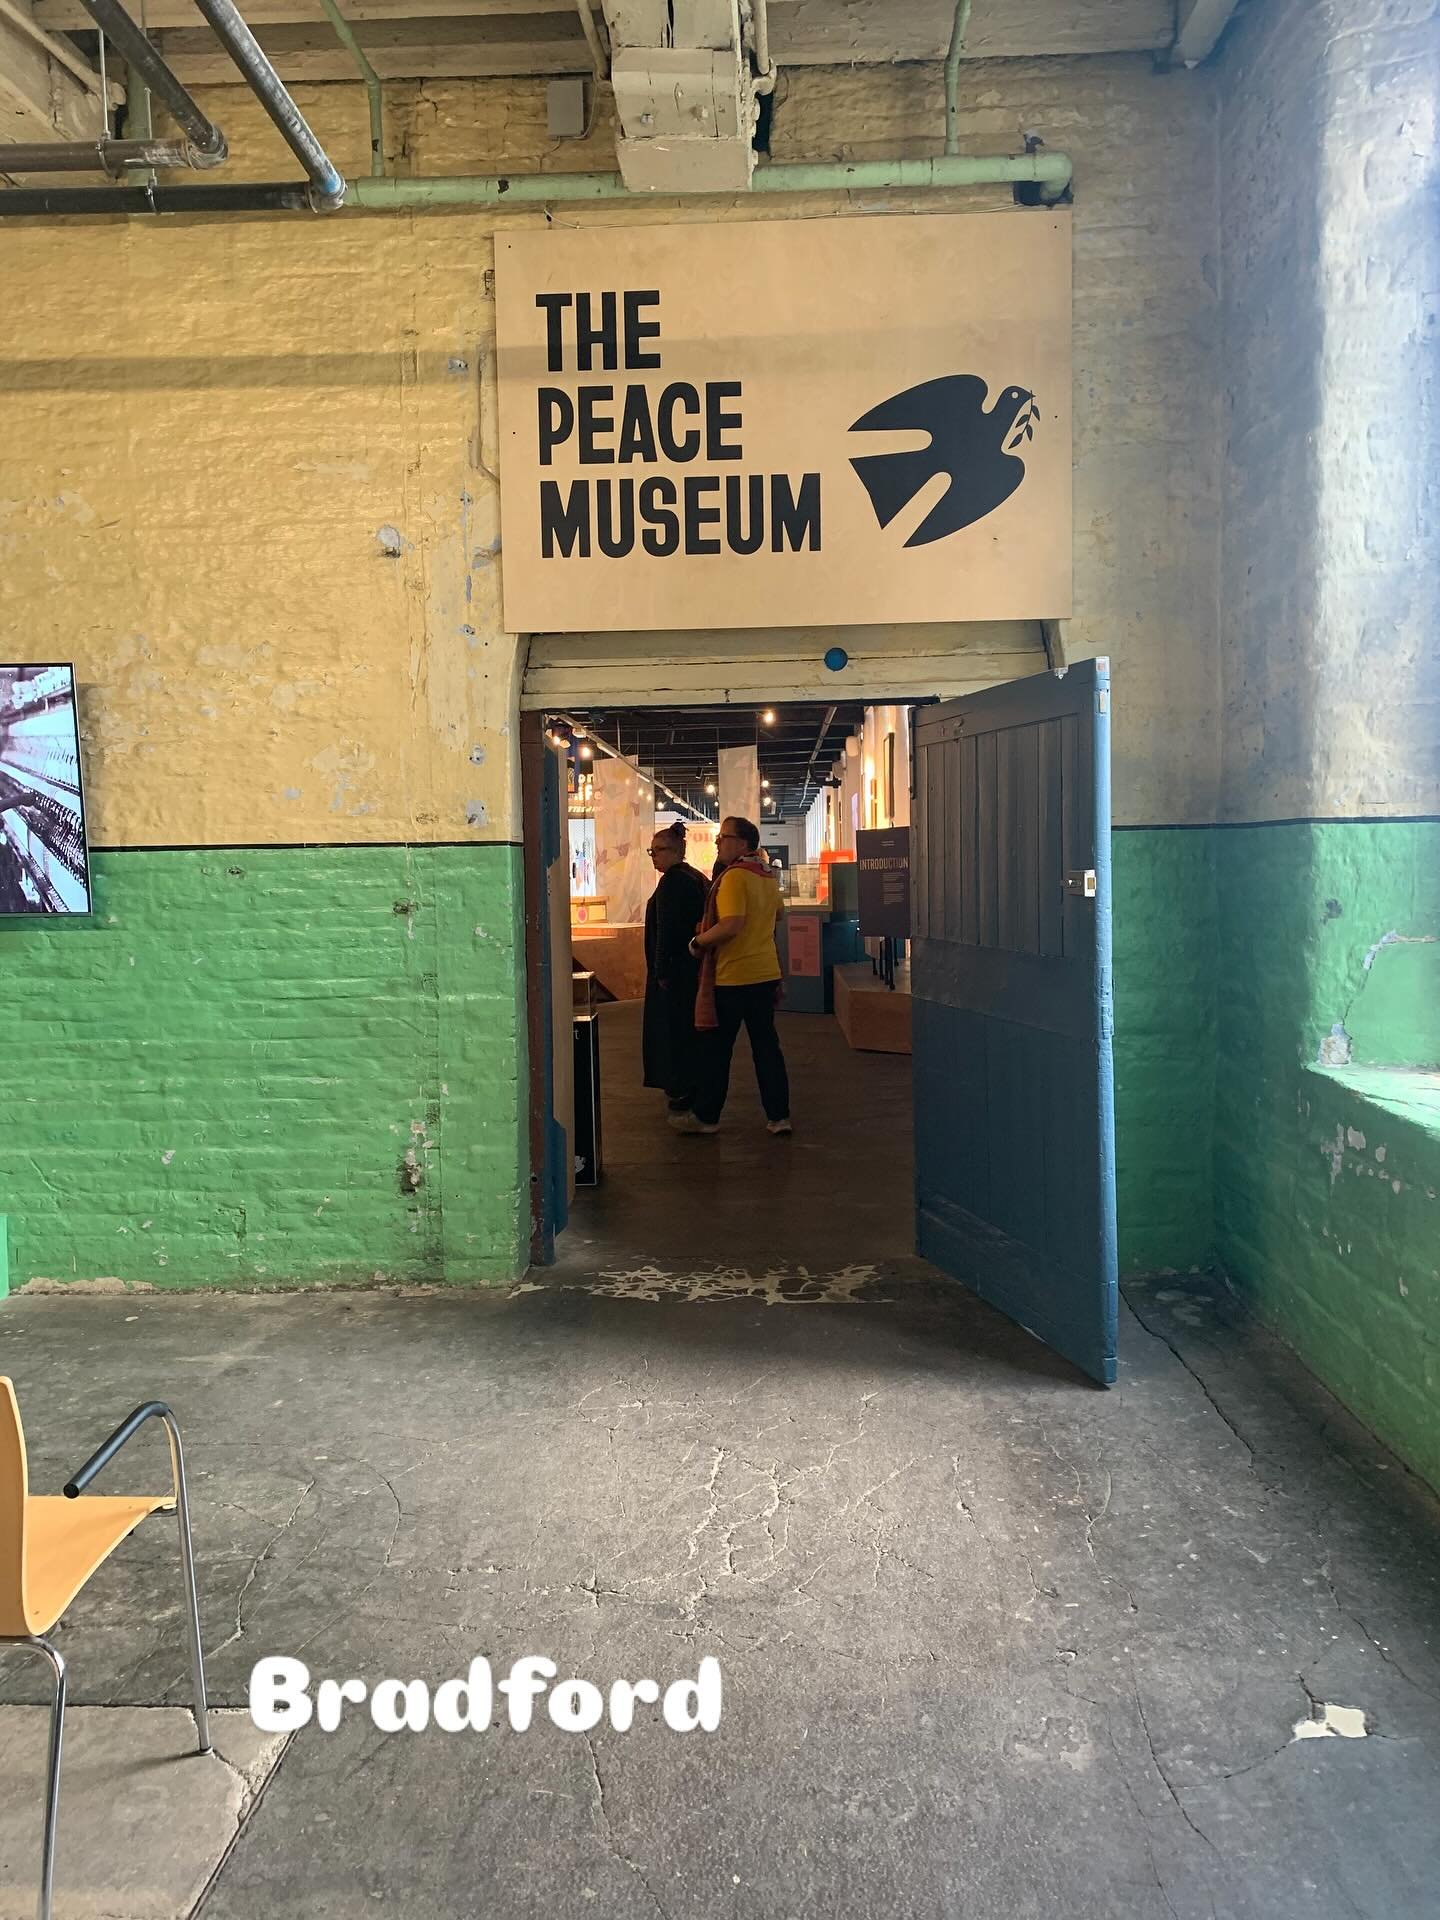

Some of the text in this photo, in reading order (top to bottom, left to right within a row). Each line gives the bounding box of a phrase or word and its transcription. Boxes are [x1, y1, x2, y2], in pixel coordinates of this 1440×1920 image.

[536, 290, 661, 372] THE
[538, 381, 743, 466] PEACE
[540, 472, 822, 559] MUSEUM
[859, 857, 909, 871] INTRODUCTION
